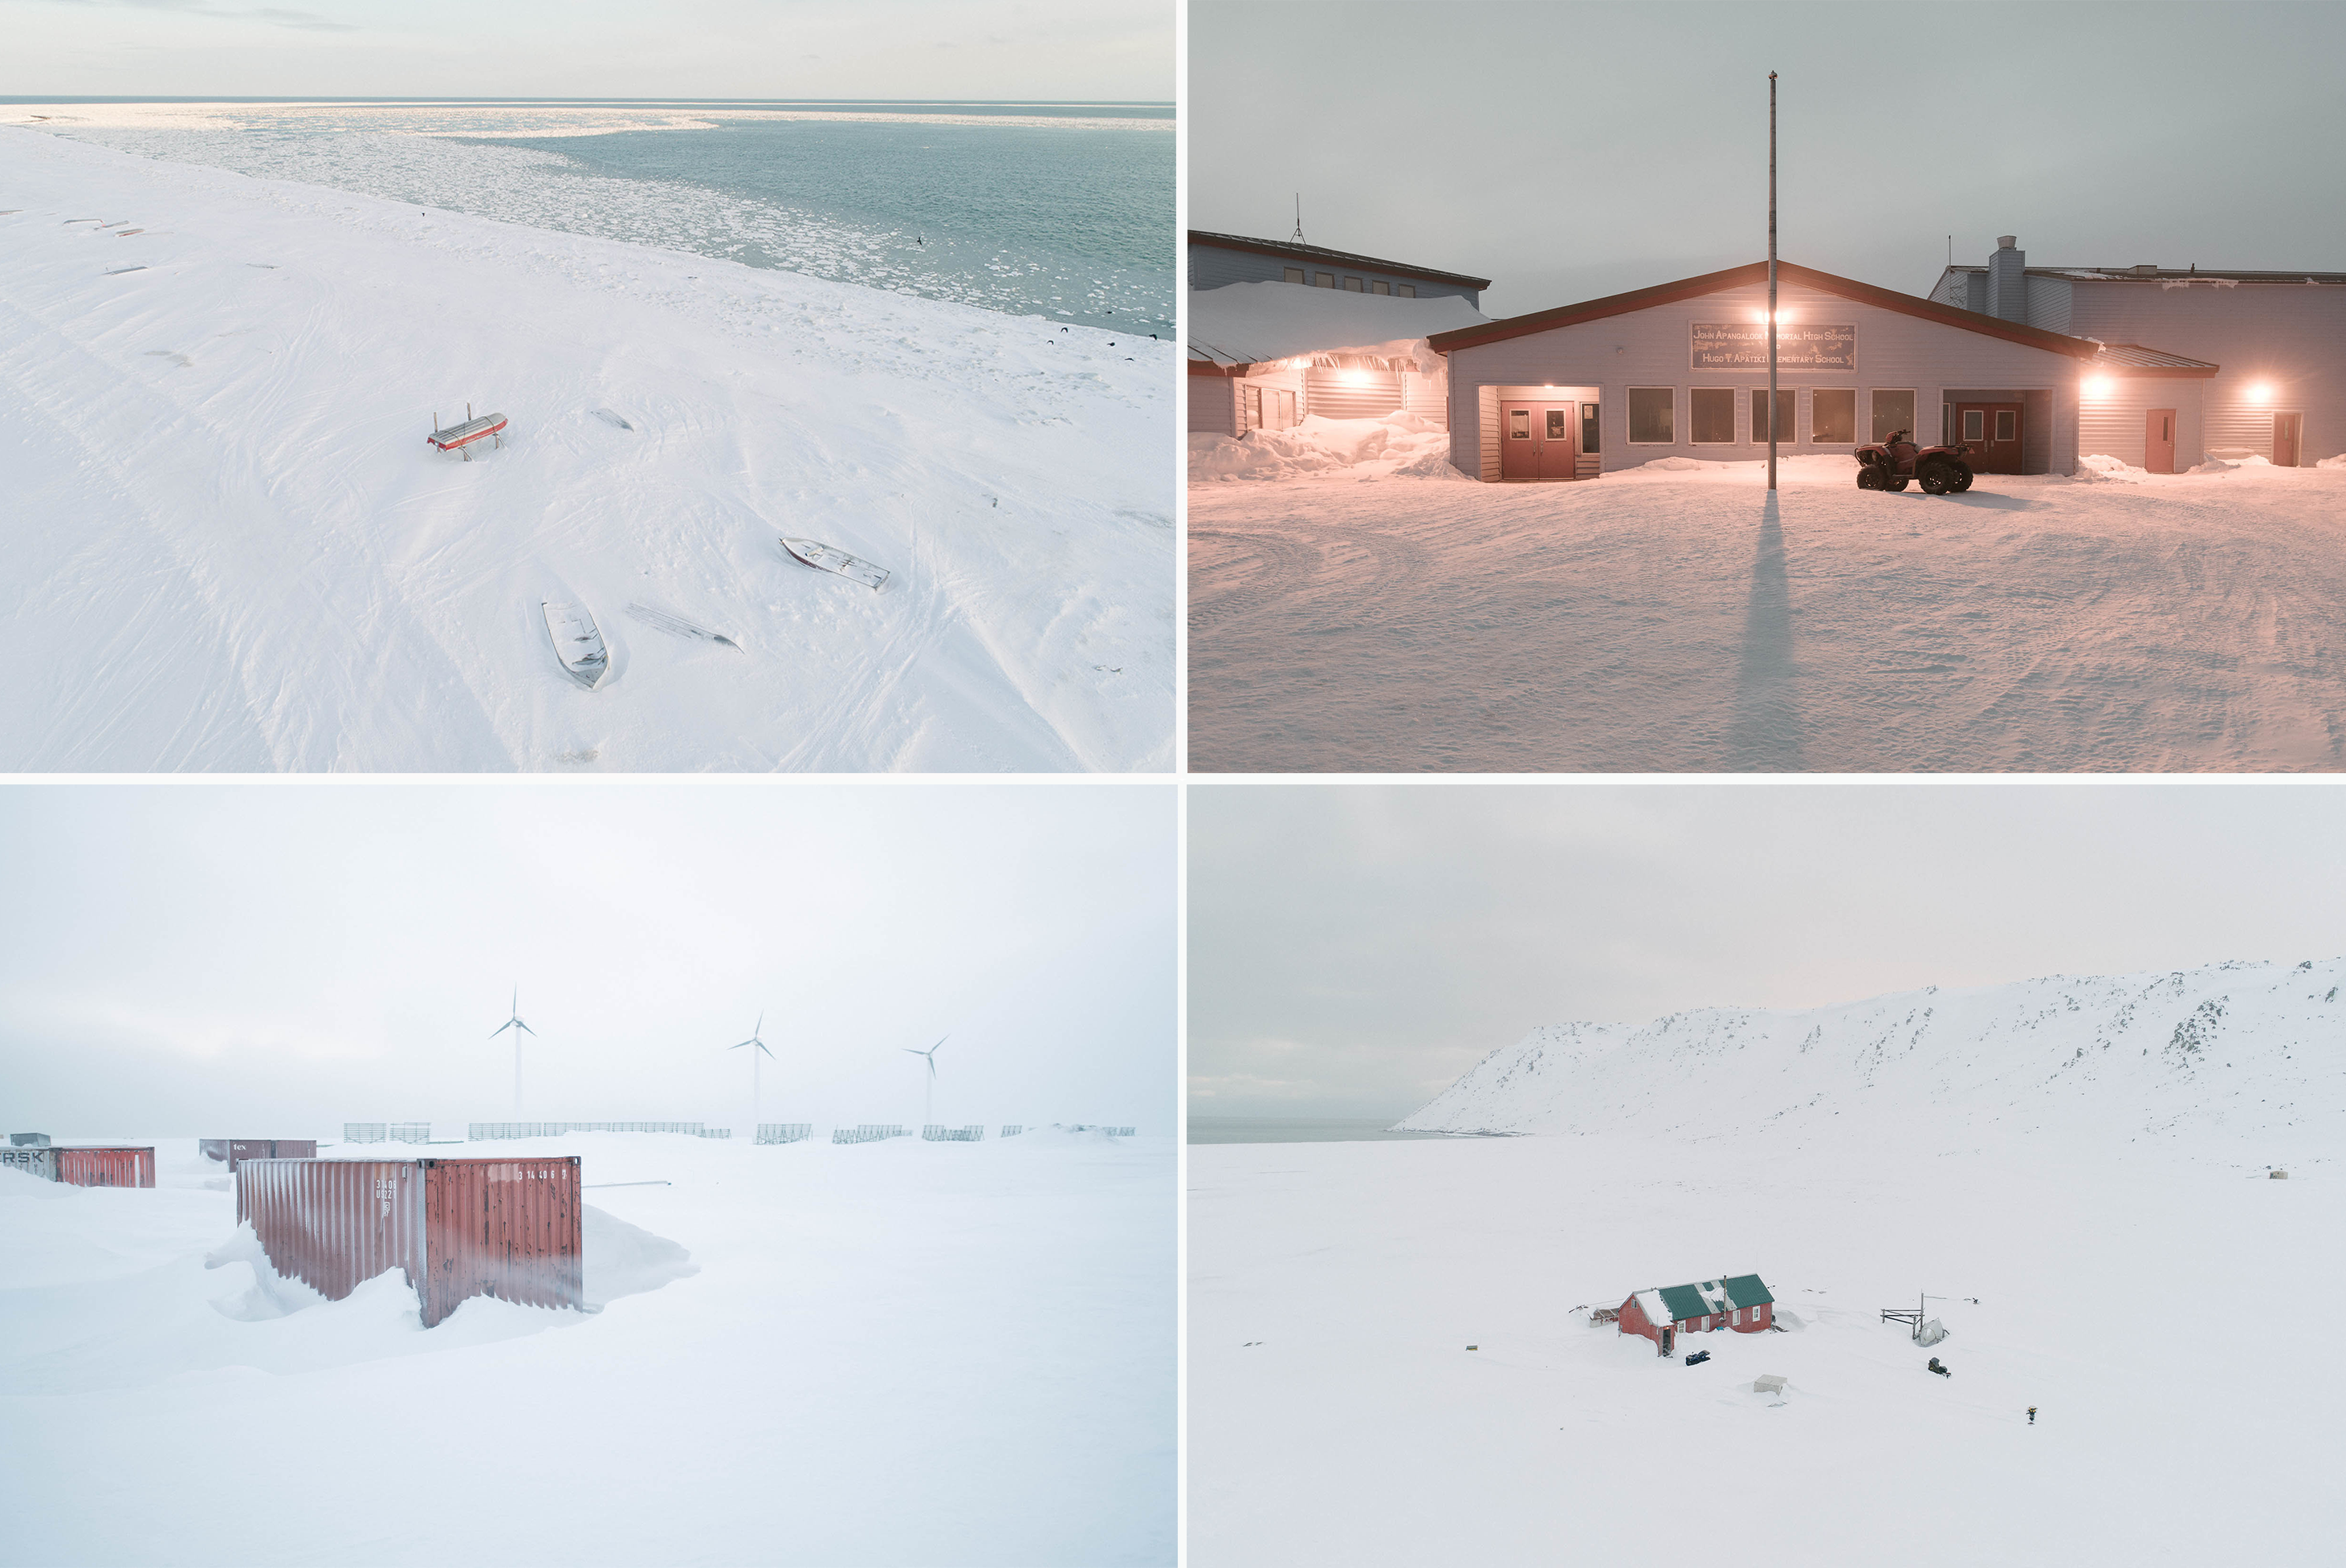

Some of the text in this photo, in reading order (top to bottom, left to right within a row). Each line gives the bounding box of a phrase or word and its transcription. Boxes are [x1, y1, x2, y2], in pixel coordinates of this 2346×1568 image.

[1693, 330, 1854, 341] JOHN APANGALOOK MMORIAL HIGH SCHOOL
[1702, 353, 1724, 363] HUGO
[1733, 353, 1766, 363] APATIKI
[1766, 353, 1814, 363] EMENTARY
[1814, 354, 1844, 364] SCHOOL
[233, 1142, 246, 1151] tex
[0, 1152, 43, 1163] RSK
